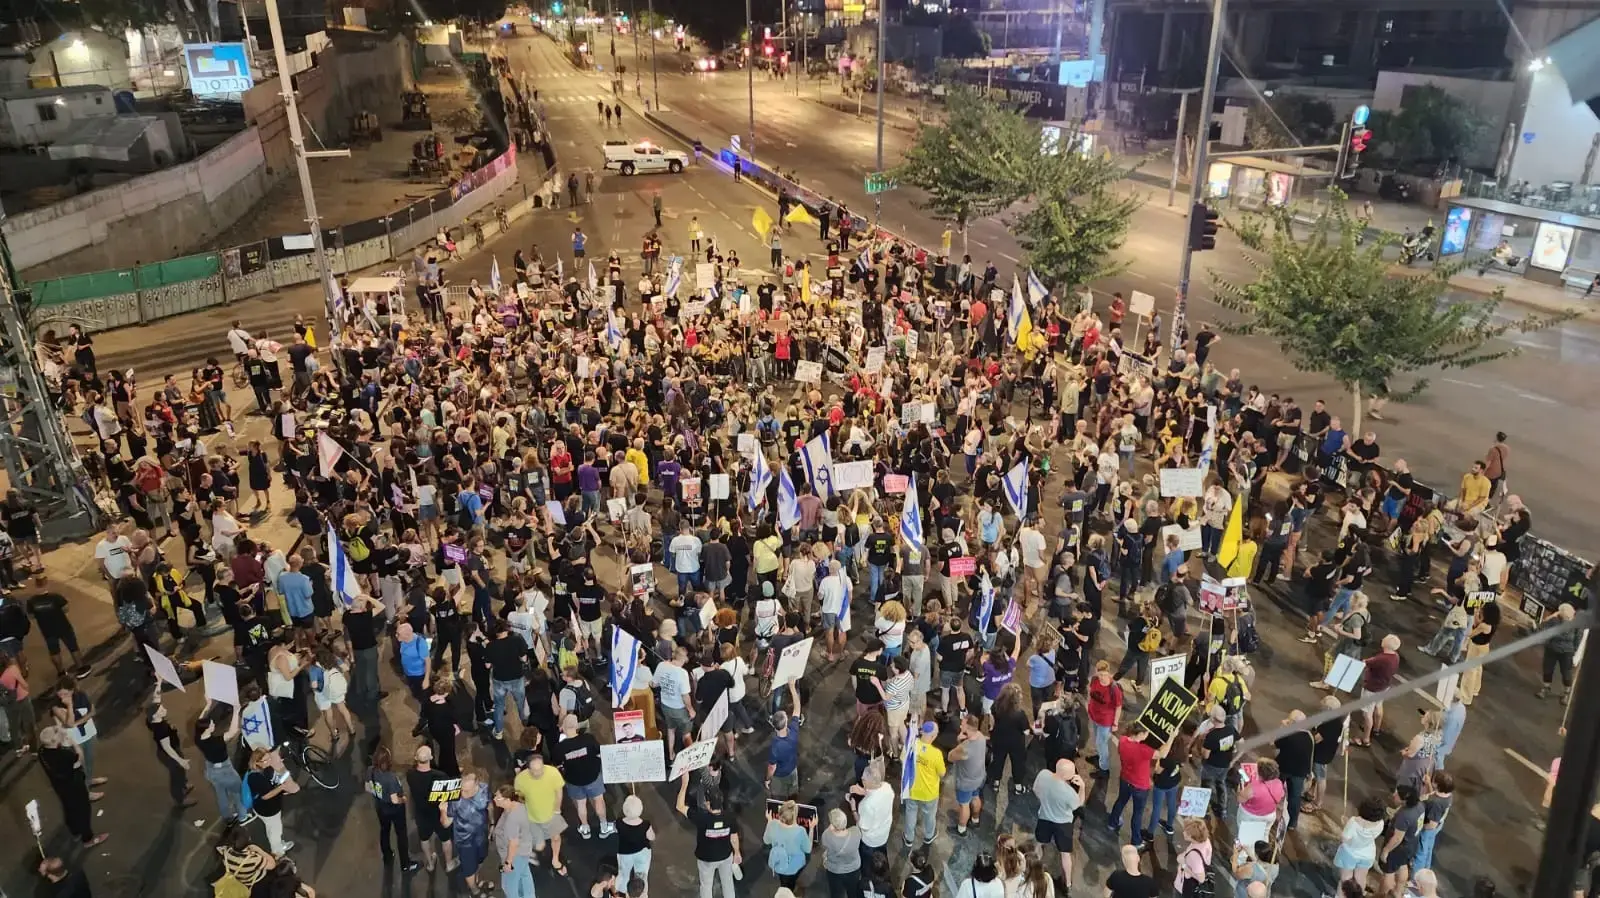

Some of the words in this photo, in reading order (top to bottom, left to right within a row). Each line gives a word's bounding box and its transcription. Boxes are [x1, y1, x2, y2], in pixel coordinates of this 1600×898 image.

[1010, 89, 1042, 104] TOWER
[1158, 689, 1190, 720] NOW
[1145, 708, 1176, 735] ALIVE
